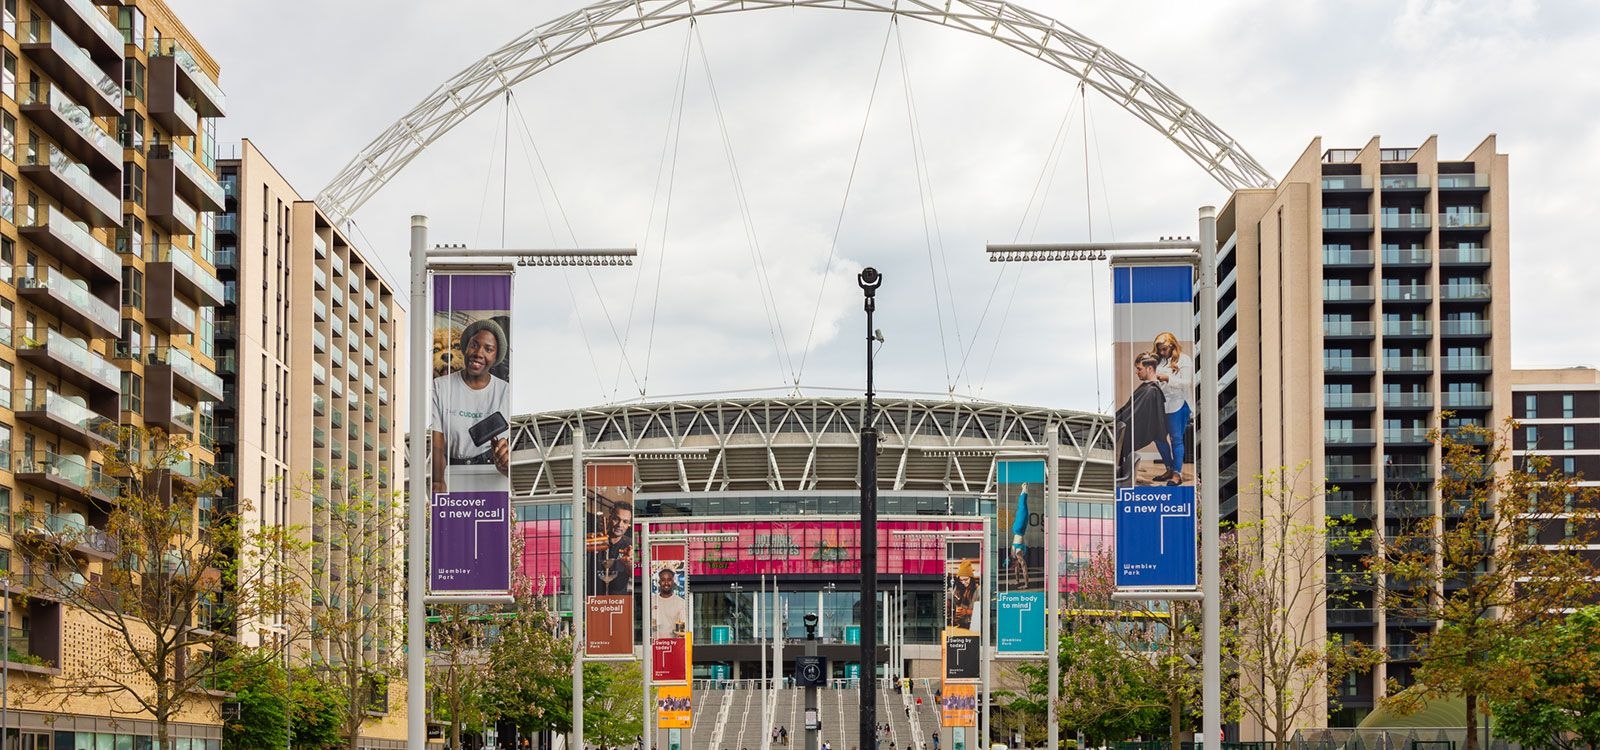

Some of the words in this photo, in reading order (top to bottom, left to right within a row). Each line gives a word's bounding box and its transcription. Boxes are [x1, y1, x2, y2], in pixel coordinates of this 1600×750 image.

[1124, 492, 1172, 501] Discover
[440, 497, 486, 506] Discover
[1160, 503, 1186, 512] local
[475, 508, 500, 517] local
